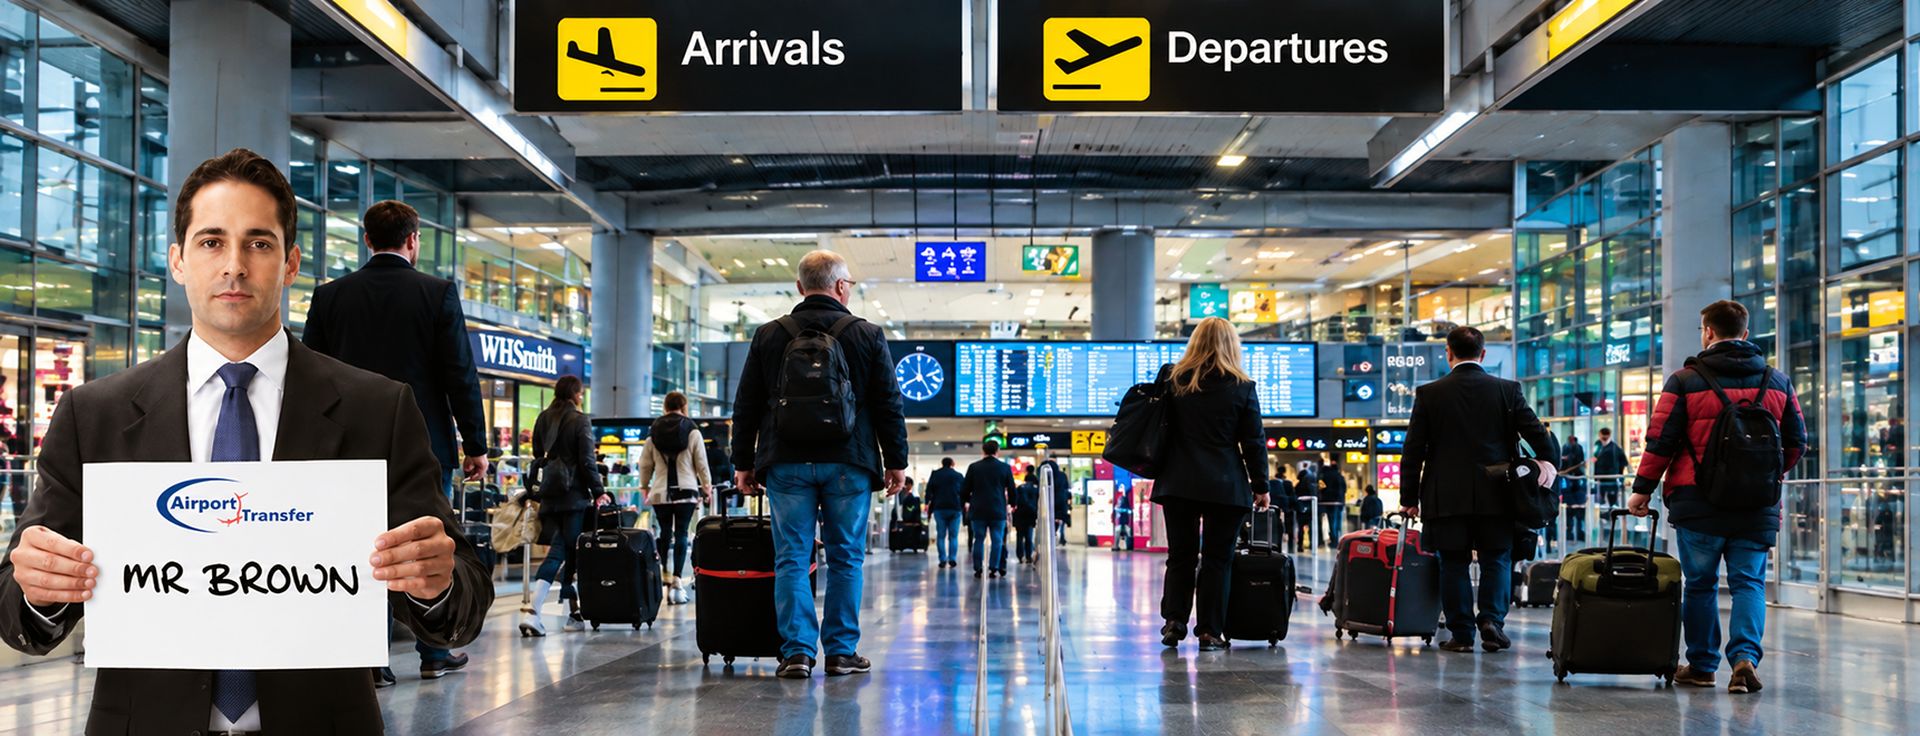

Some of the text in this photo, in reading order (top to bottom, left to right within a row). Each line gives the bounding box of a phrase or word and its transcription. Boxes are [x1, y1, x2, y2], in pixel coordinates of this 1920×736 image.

[681, 30, 846, 67] Arrivals
[1168, 30, 1389, 72] Departures
[479, 333, 557, 375] WHSmith
[170, 495, 238, 513] Airport
[242, 508, 314, 522] Transfer
[123, 560, 359, 596] MR BROWN
